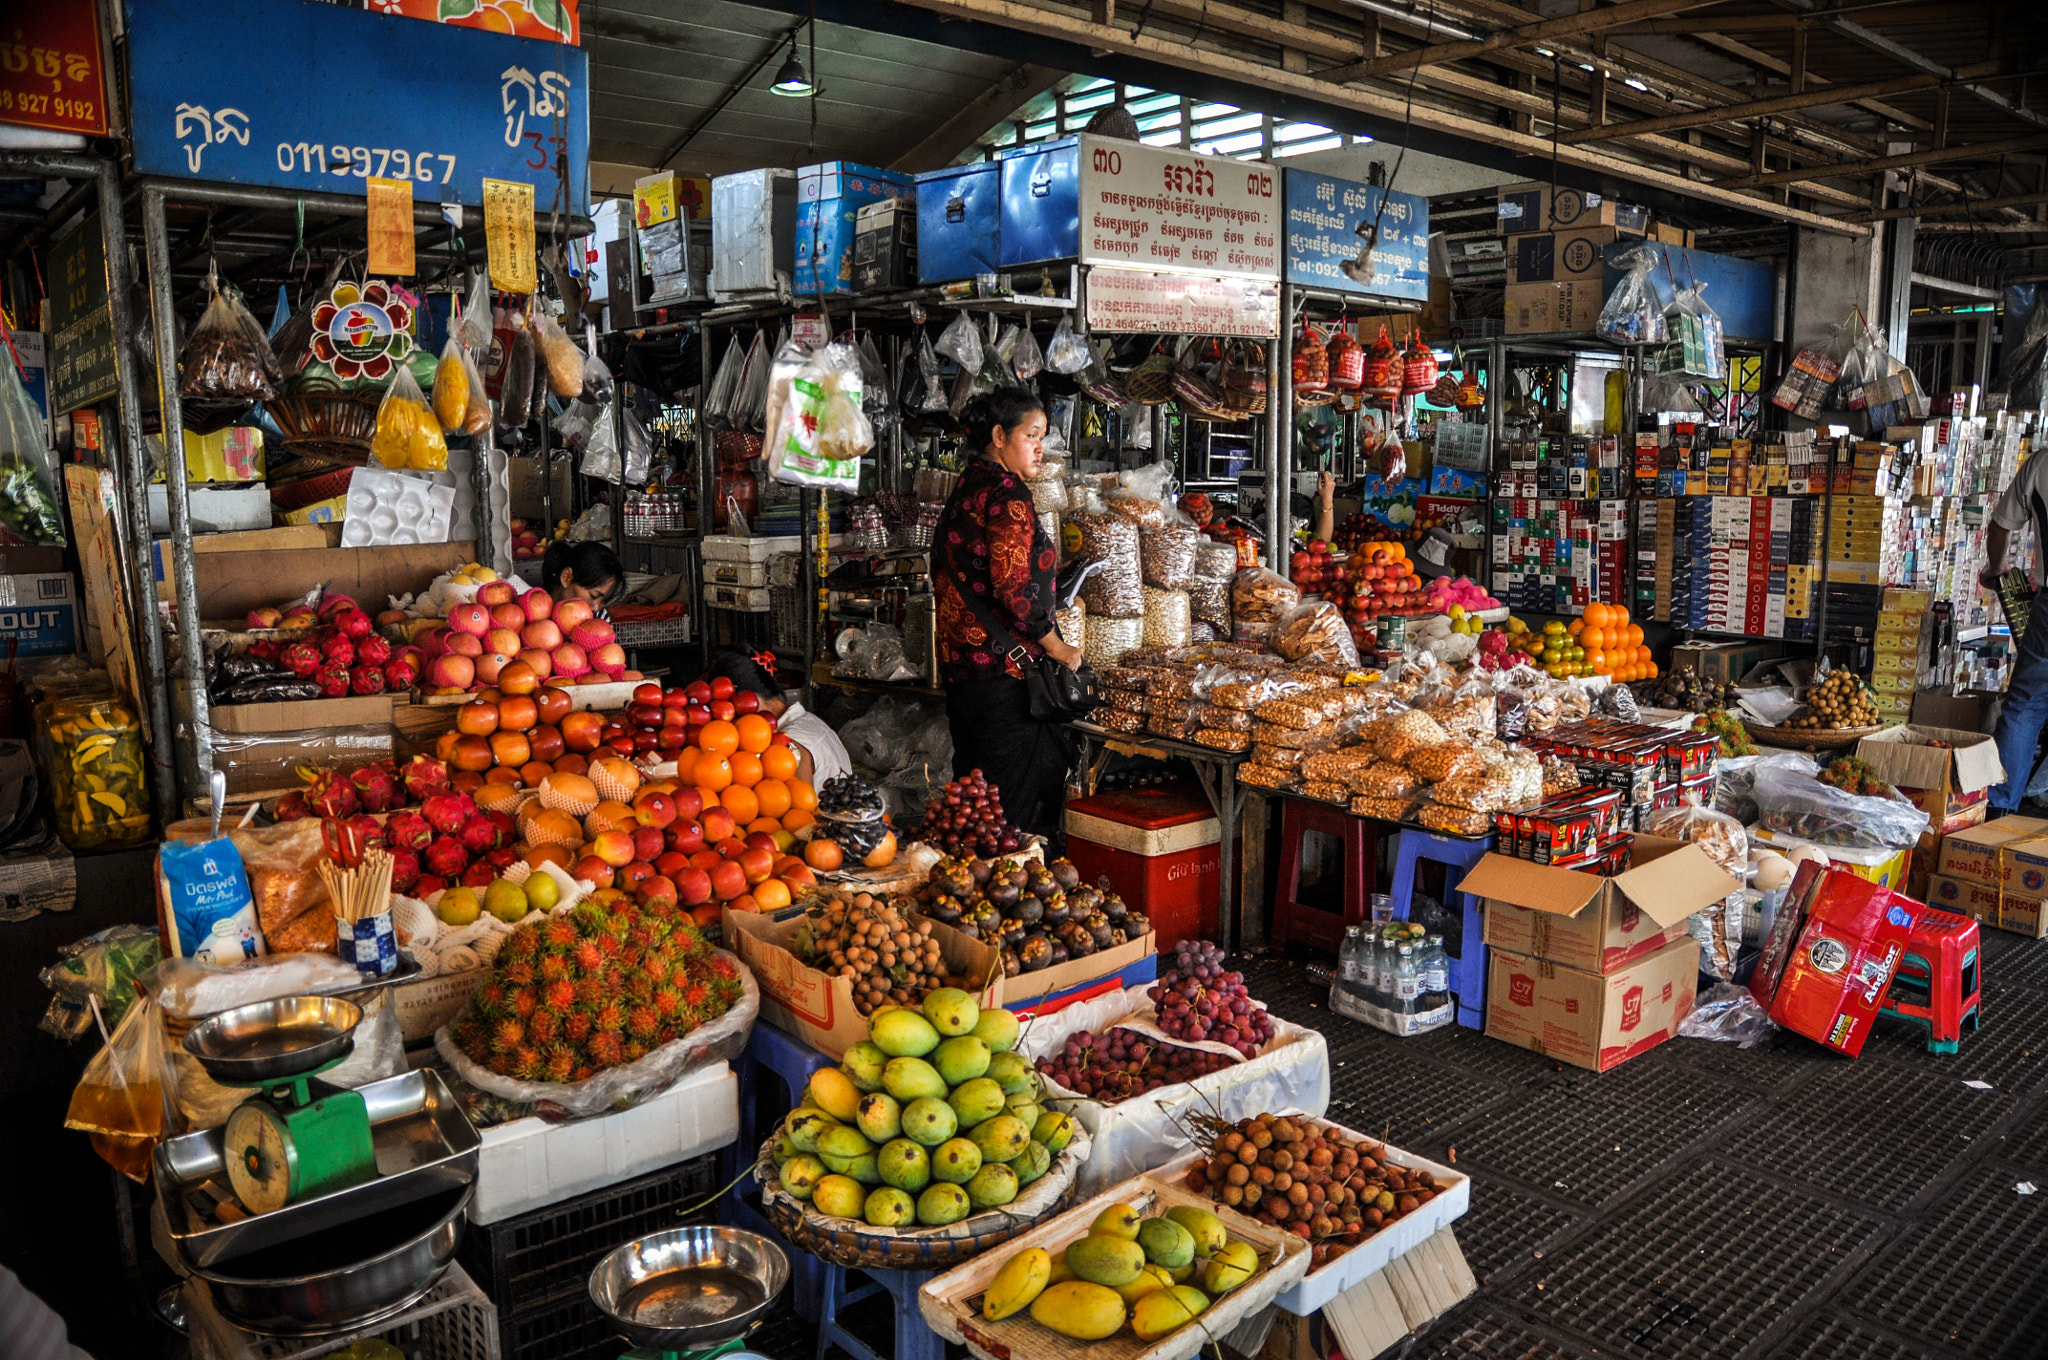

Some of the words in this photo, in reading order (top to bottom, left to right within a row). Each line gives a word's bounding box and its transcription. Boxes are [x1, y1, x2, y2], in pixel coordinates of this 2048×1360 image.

[18, 92, 48, 114] 927
[54, 97, 94, 120] 9192
[276, 142, 456, 184] 011997967
[343, 324, 379, 333] WASHINGTON
[1429, 503, 1459, 513] APPLE
[185, 870, 237, 897] มิตรผล
[1864, 944, 1901, 1004] Angkor
